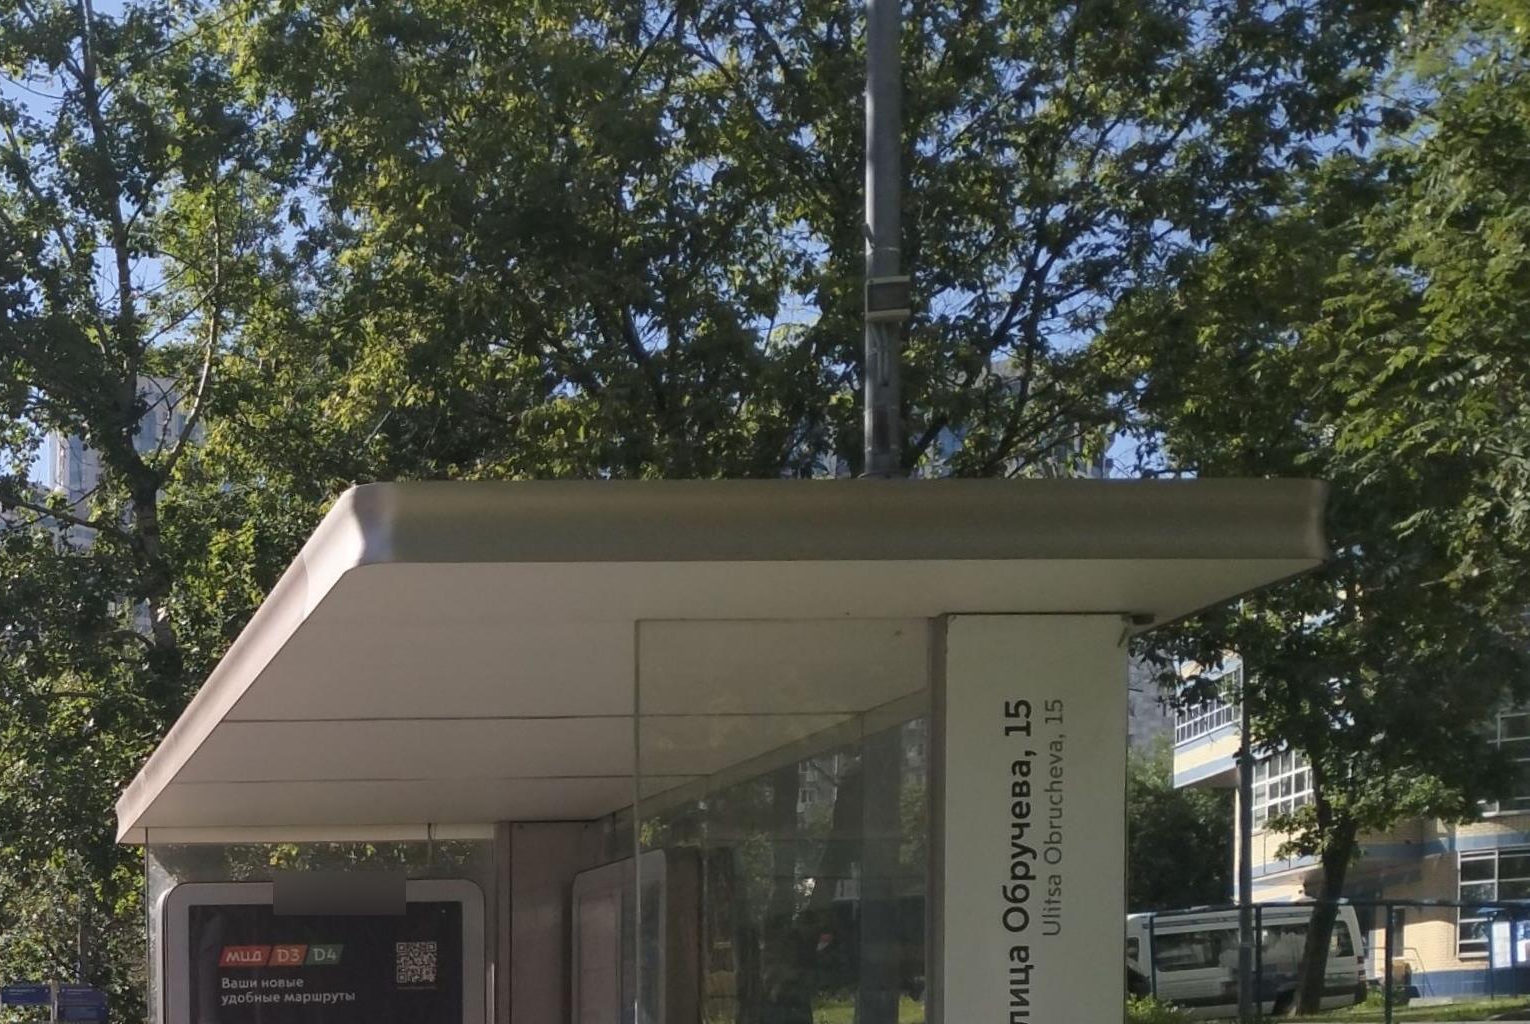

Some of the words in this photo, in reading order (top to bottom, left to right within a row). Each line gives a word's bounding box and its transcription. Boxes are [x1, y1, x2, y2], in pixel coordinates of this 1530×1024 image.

[1005, 699, 1032, 737] 15
[1045, 699, 1063, 724] 15
[1044, 733, 1067, 865] Obrucheva,
[1002, 749, 1037, 933] Обручева,
[1042, 874, 1062, 935] Ulitsa
[277, 949, 301, 962] D3
[314, 949, 337, 962] D4
[221, 977, 257, 989] Ваши
[261, 978, 304, 988] новые
[221, 990, 281, 1005] удобные
[284, 991, 356, 1005] маршруты
